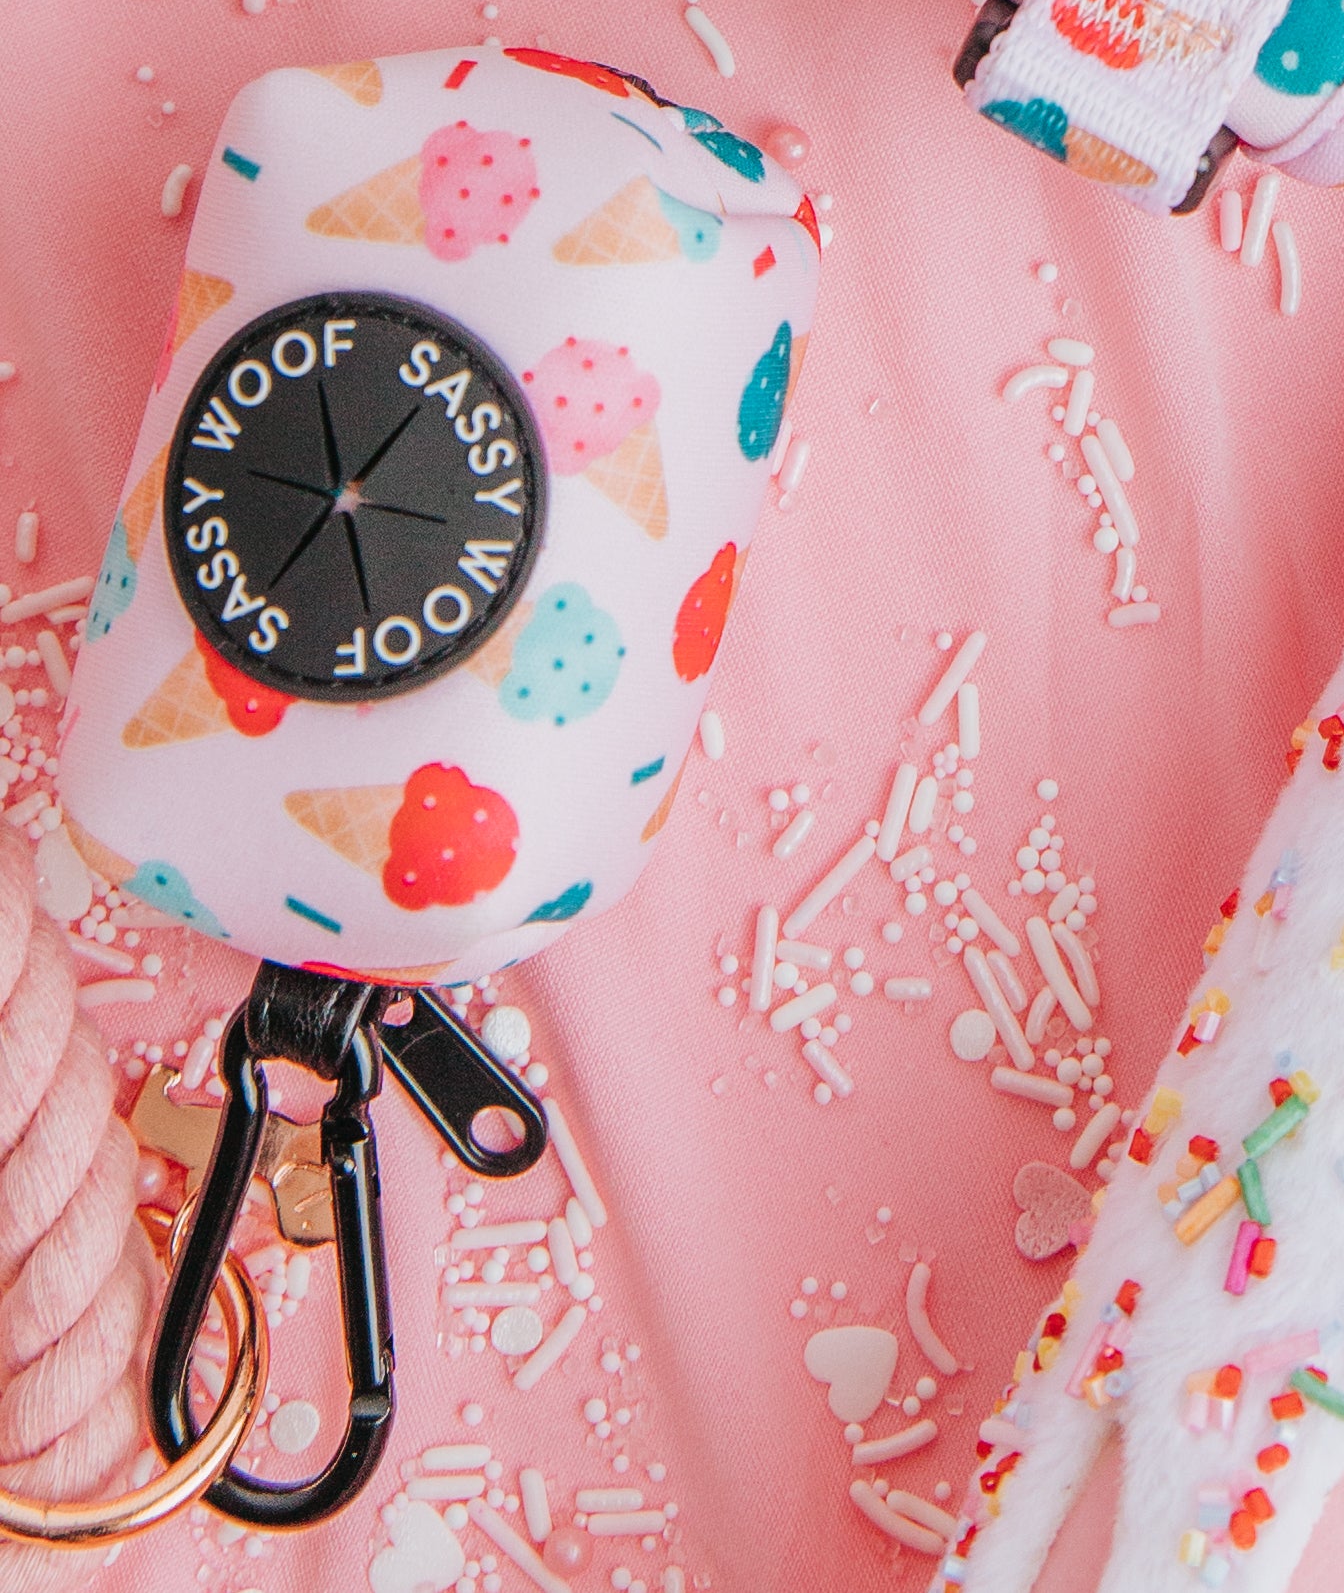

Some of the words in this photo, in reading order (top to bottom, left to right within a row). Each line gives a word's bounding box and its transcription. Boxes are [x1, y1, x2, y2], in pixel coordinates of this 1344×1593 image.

[191, 318, 358, 453] WOOF
[398, 339, 523, 517] SASSY
[181, 476, 291, 655] SASSY
[332, 538, 516, 678] WOOF
